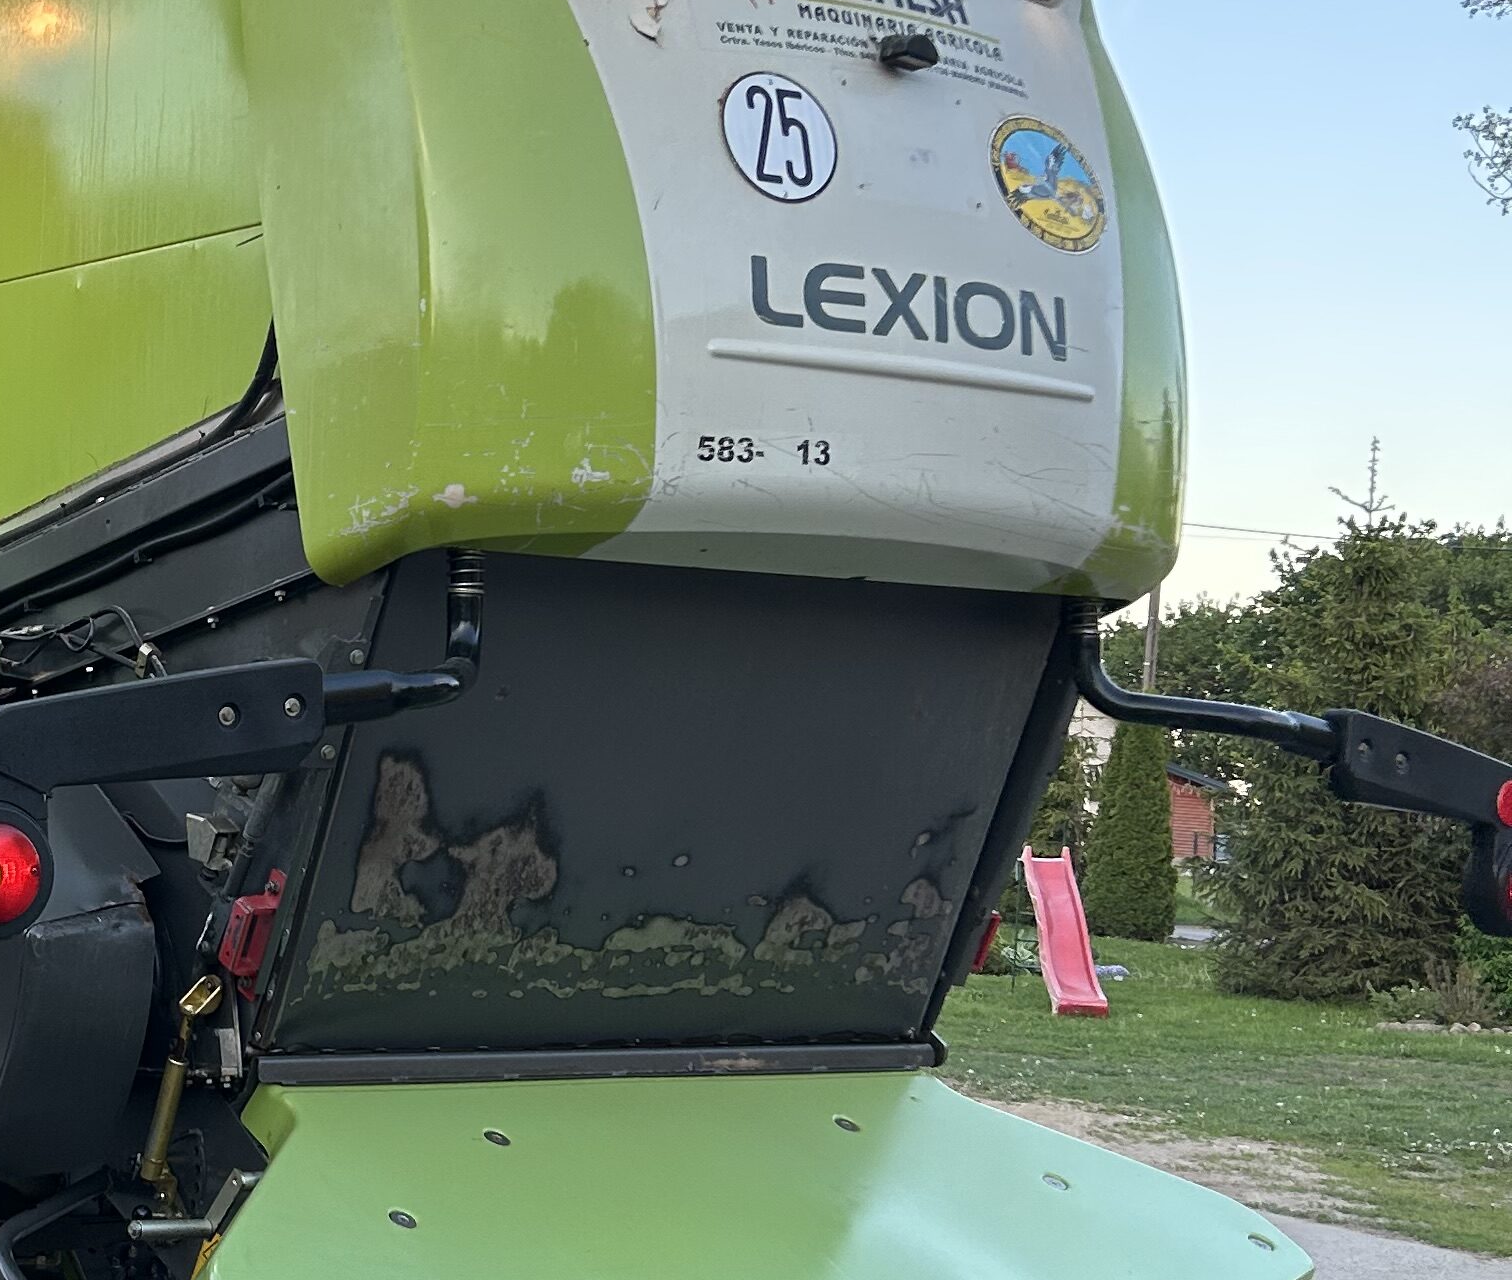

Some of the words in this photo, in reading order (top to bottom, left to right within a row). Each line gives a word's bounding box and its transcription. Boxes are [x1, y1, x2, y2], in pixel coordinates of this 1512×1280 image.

[716, 21, 762, 36] VENTA
[769, 25, 779, 37] Y
[746, 85, 813, 187] 25
[750, 255, 1067, 362] LEXION
[796, 439, 831, 466] 13
